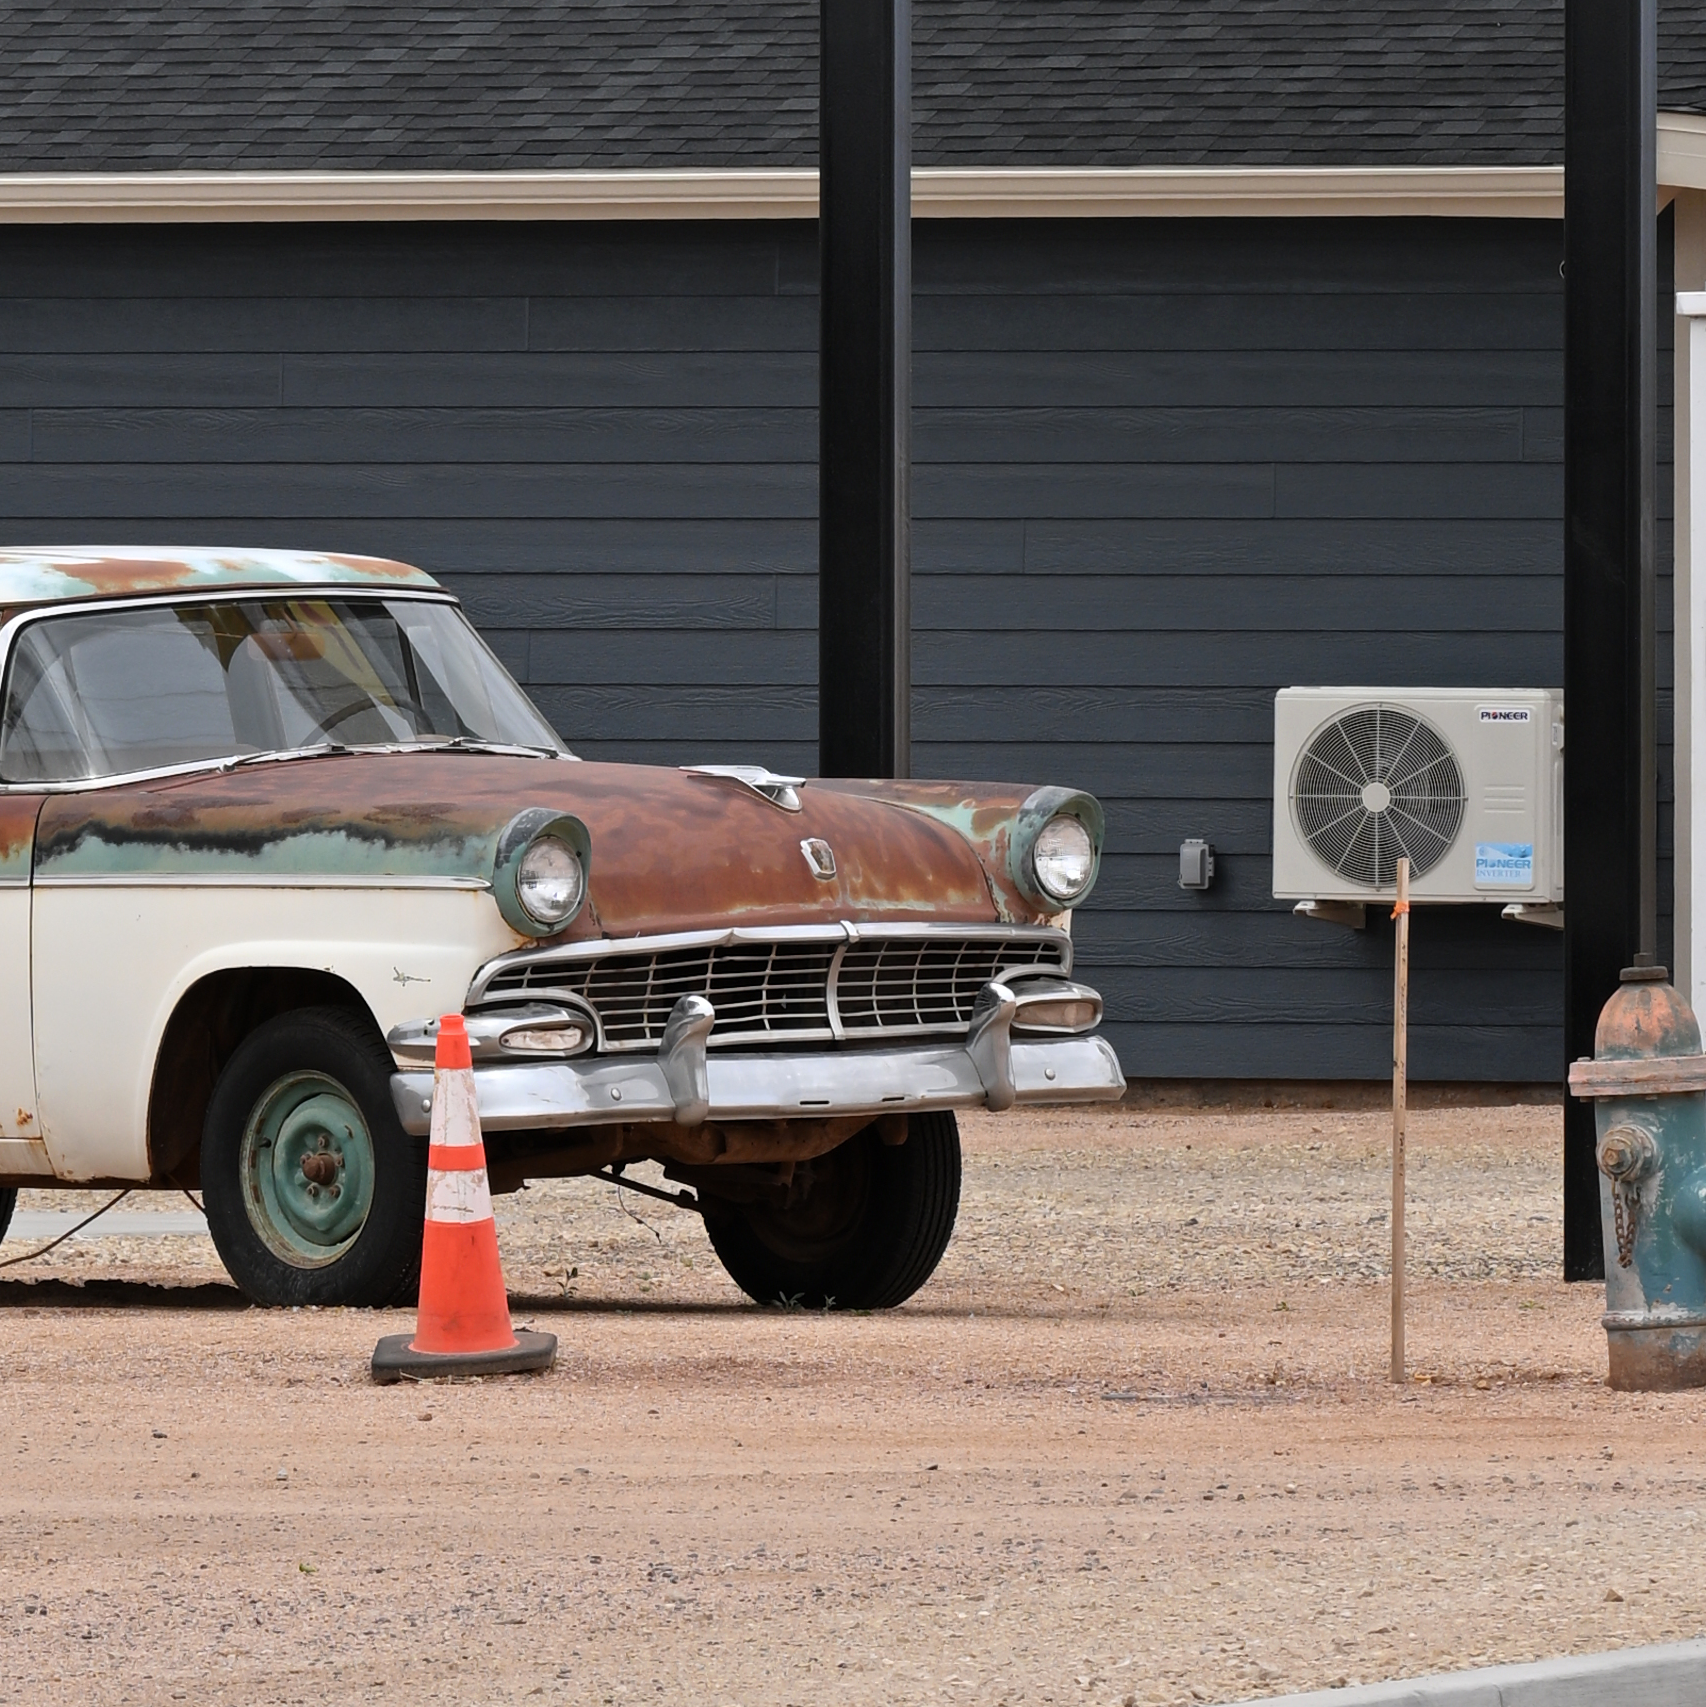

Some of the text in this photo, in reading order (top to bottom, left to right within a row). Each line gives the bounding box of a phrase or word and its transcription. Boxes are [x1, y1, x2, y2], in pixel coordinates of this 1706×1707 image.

[1480, 711, 1529, 721] PIONEER
[1476, 858, 1531, 869] PIONEER
[1476, 870, 1522, 878] INVERTER
